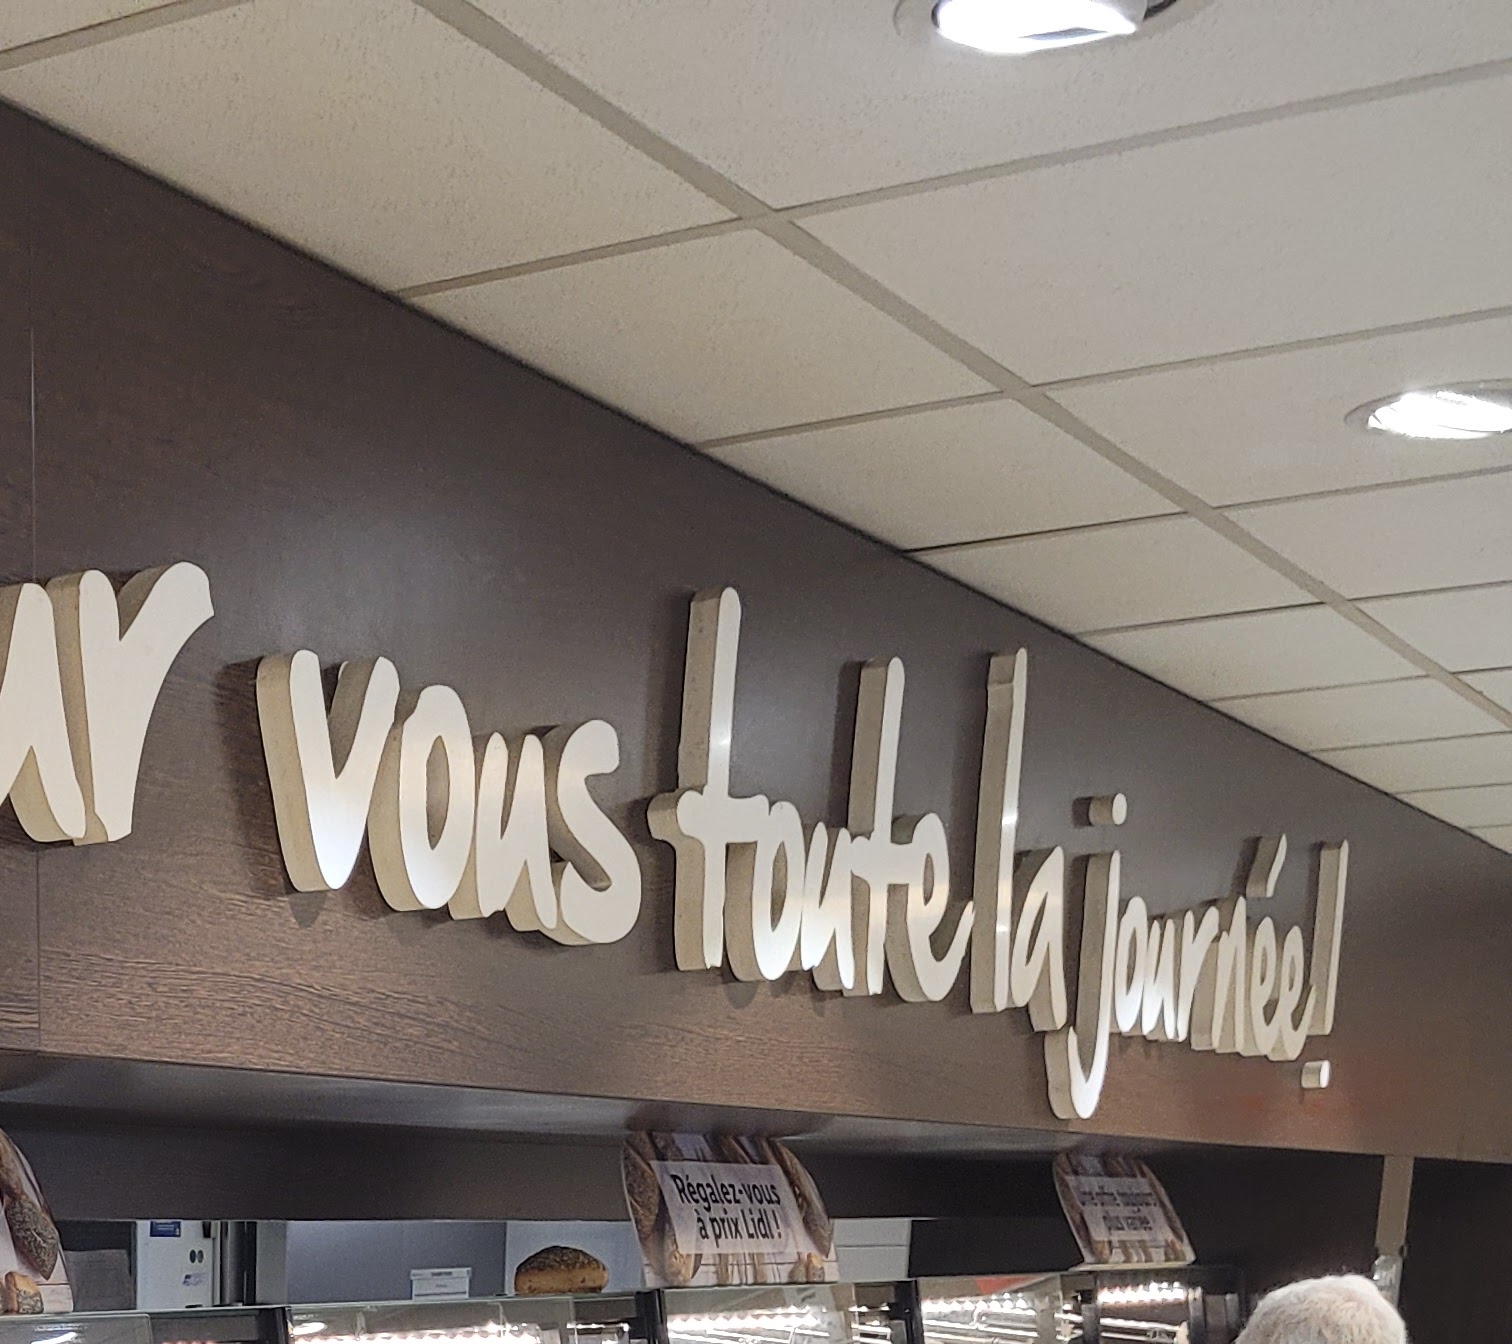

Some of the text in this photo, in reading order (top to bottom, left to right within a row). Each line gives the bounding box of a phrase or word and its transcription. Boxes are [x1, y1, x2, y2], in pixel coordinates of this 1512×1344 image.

[256, 649, 642, 945] vous
[648, 586, 974, 1004] toute
[970, 648, 1066, 1032] la
[670, 1173, 781, 1213] Régalez-vous
[694, 1208, 709, 1240] à
[709, 1208, 744, 1249] prix
[741, 1208, 774, 1239] Lidl
